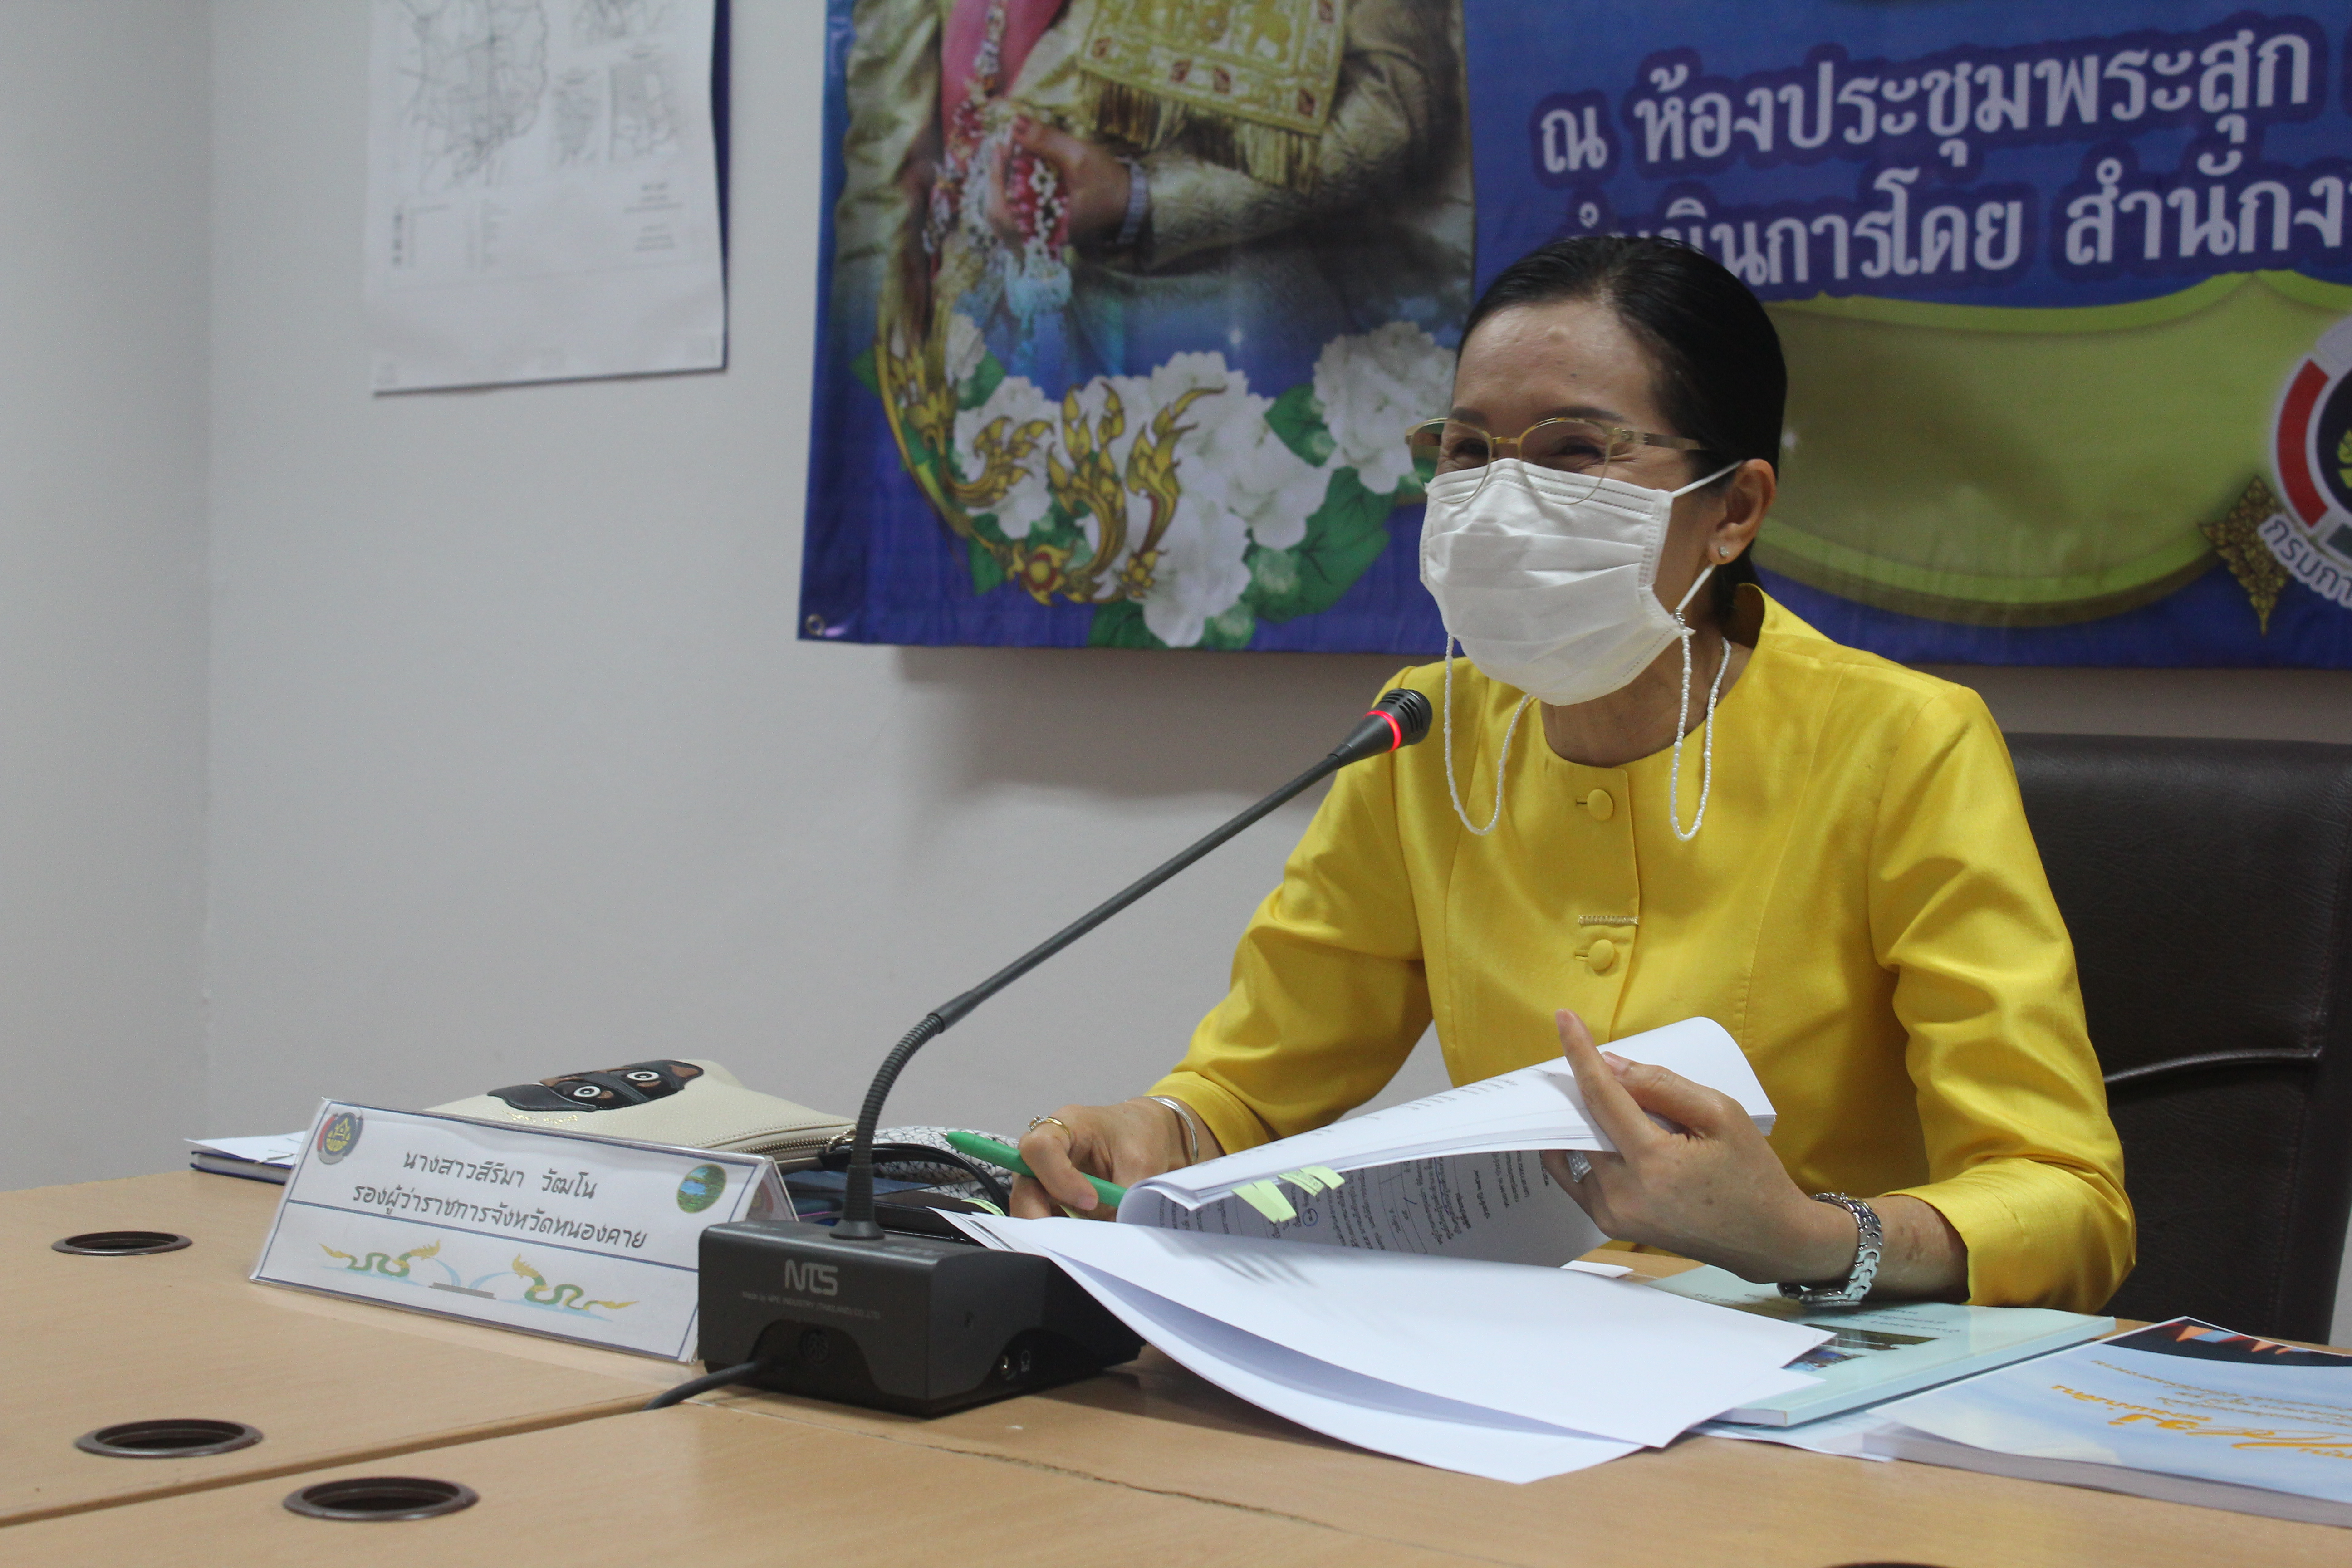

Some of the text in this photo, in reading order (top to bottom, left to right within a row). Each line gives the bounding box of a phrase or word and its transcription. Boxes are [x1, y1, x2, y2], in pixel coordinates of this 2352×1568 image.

[1541, 29, 2310, 173] ณ ห้องประชุมพระสุก
[2066, 150, 2352, 265] สำนักง
[353, 1184, 648, 1249] รองผู้ว่าราชการจังหวัดหนองคาย
[542, 1168, 598, 1199] วัฒโน
